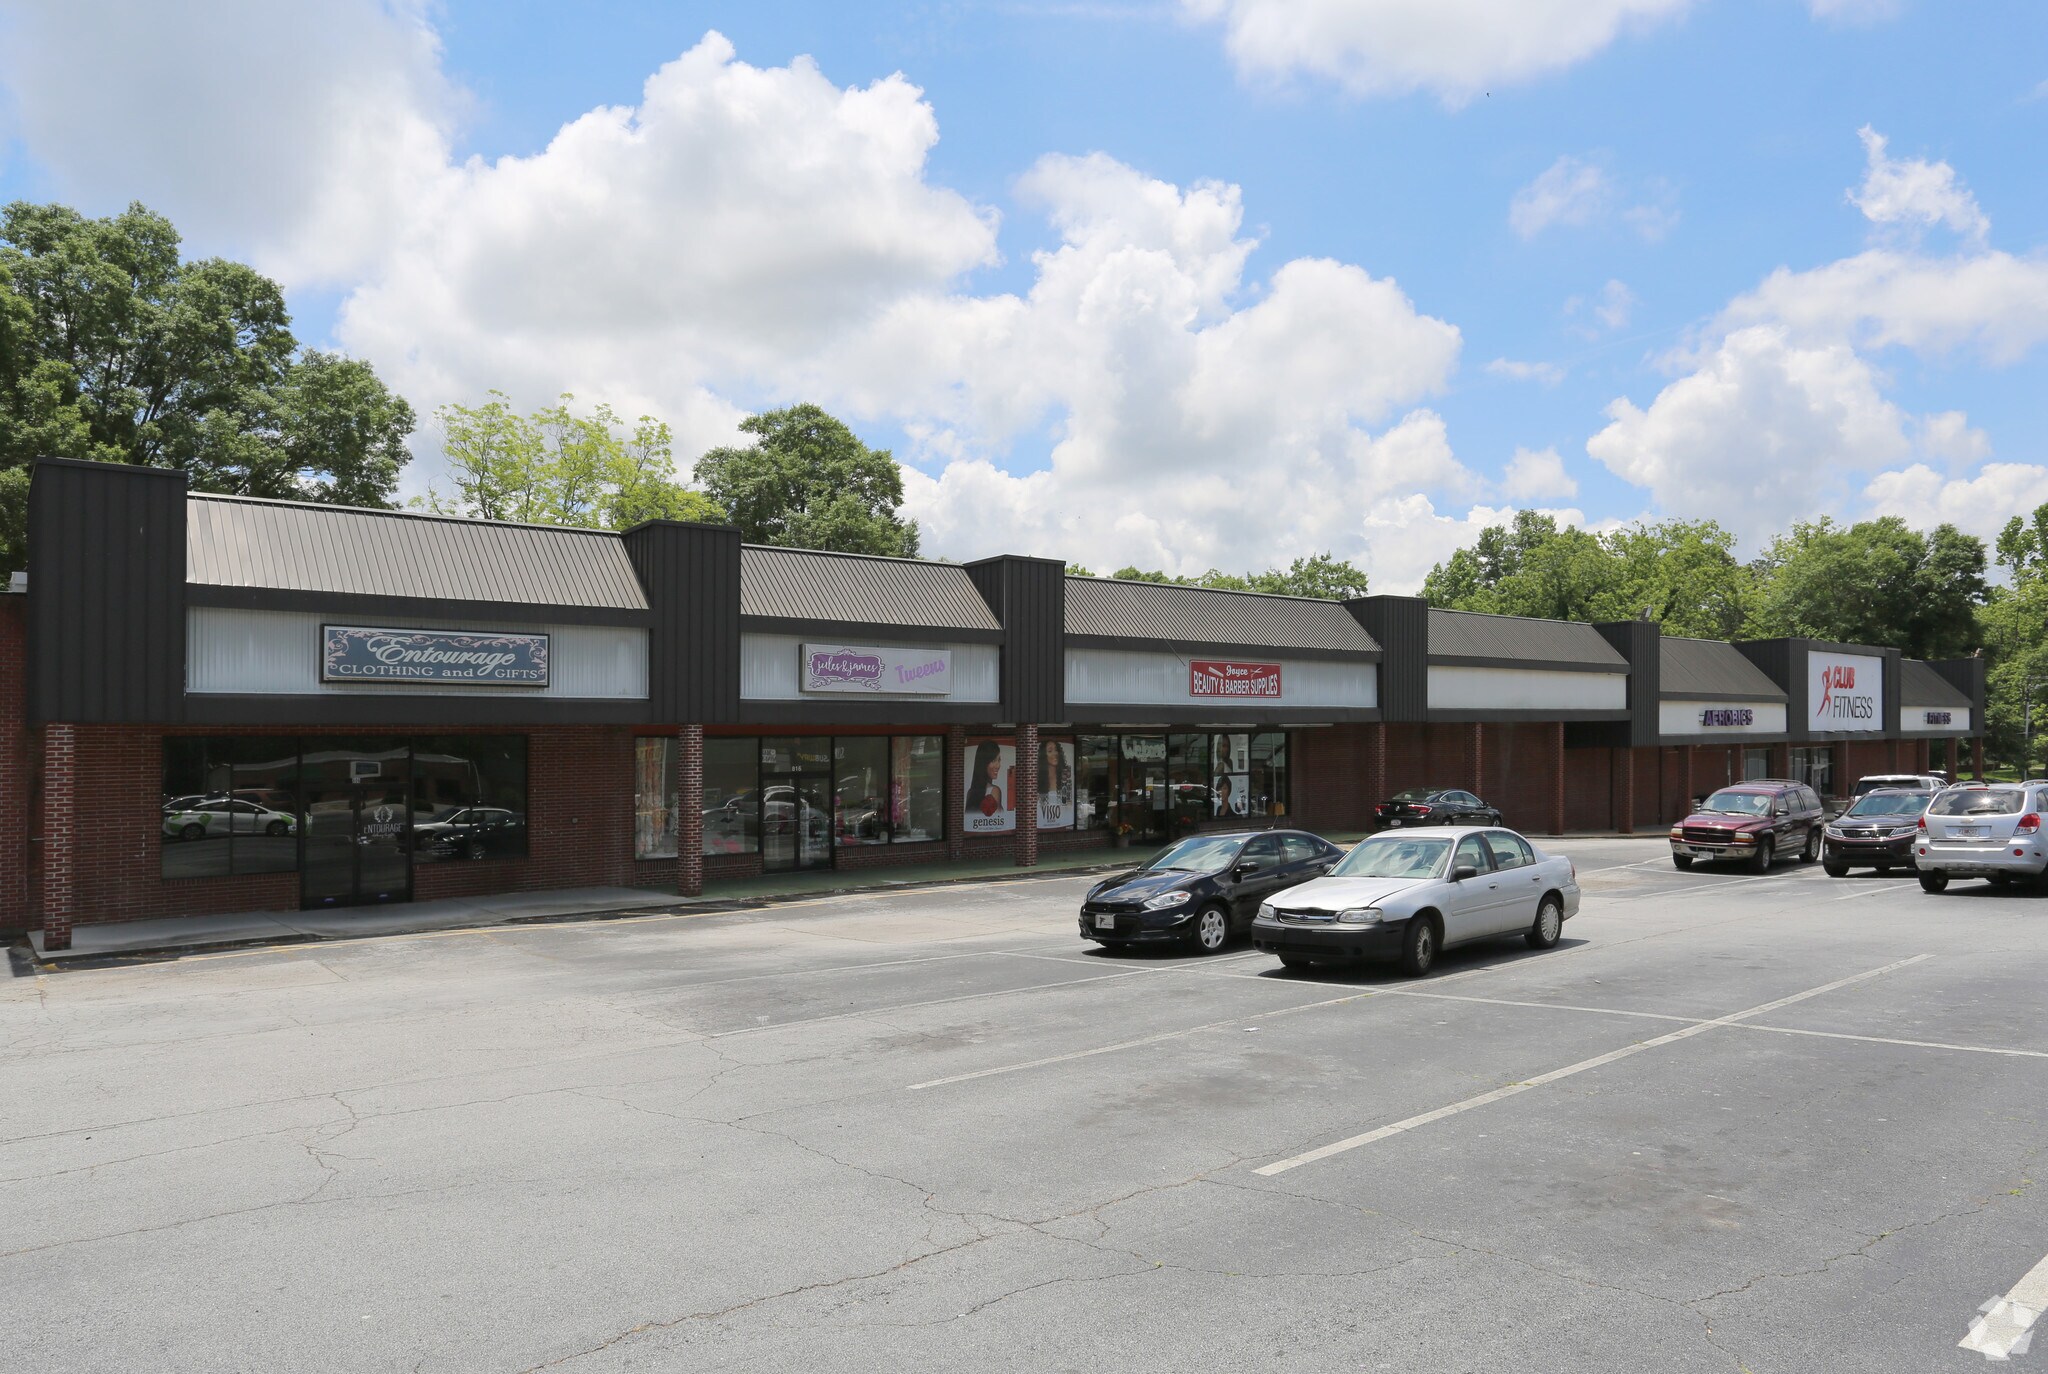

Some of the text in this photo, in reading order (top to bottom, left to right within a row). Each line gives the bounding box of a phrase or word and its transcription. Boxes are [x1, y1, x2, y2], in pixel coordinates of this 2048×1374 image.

[367, 636, 516, 676] Entourage
[339, 664, 538, 679] CLOTHING and GIFTS
[895, 659, 945, 684] Tweens
[1226, 665, 1248, 677] Joyce
[1832, 666, 1855, 689] CLUB
[1193, 671, 1278, 695] BEAUTY & BARBER SUPPLIES
[1833, 697, 1873, 719] FITNESS
[1703, 709, 1753, 726] AEROBICS
[1927, 712, 1952, 725] FITNESS
[1041, 805, 1061, 820] VISSO
[363, 823, 403, 834] ENTOURAGE
[972, 815, 1005, 829] genesis
